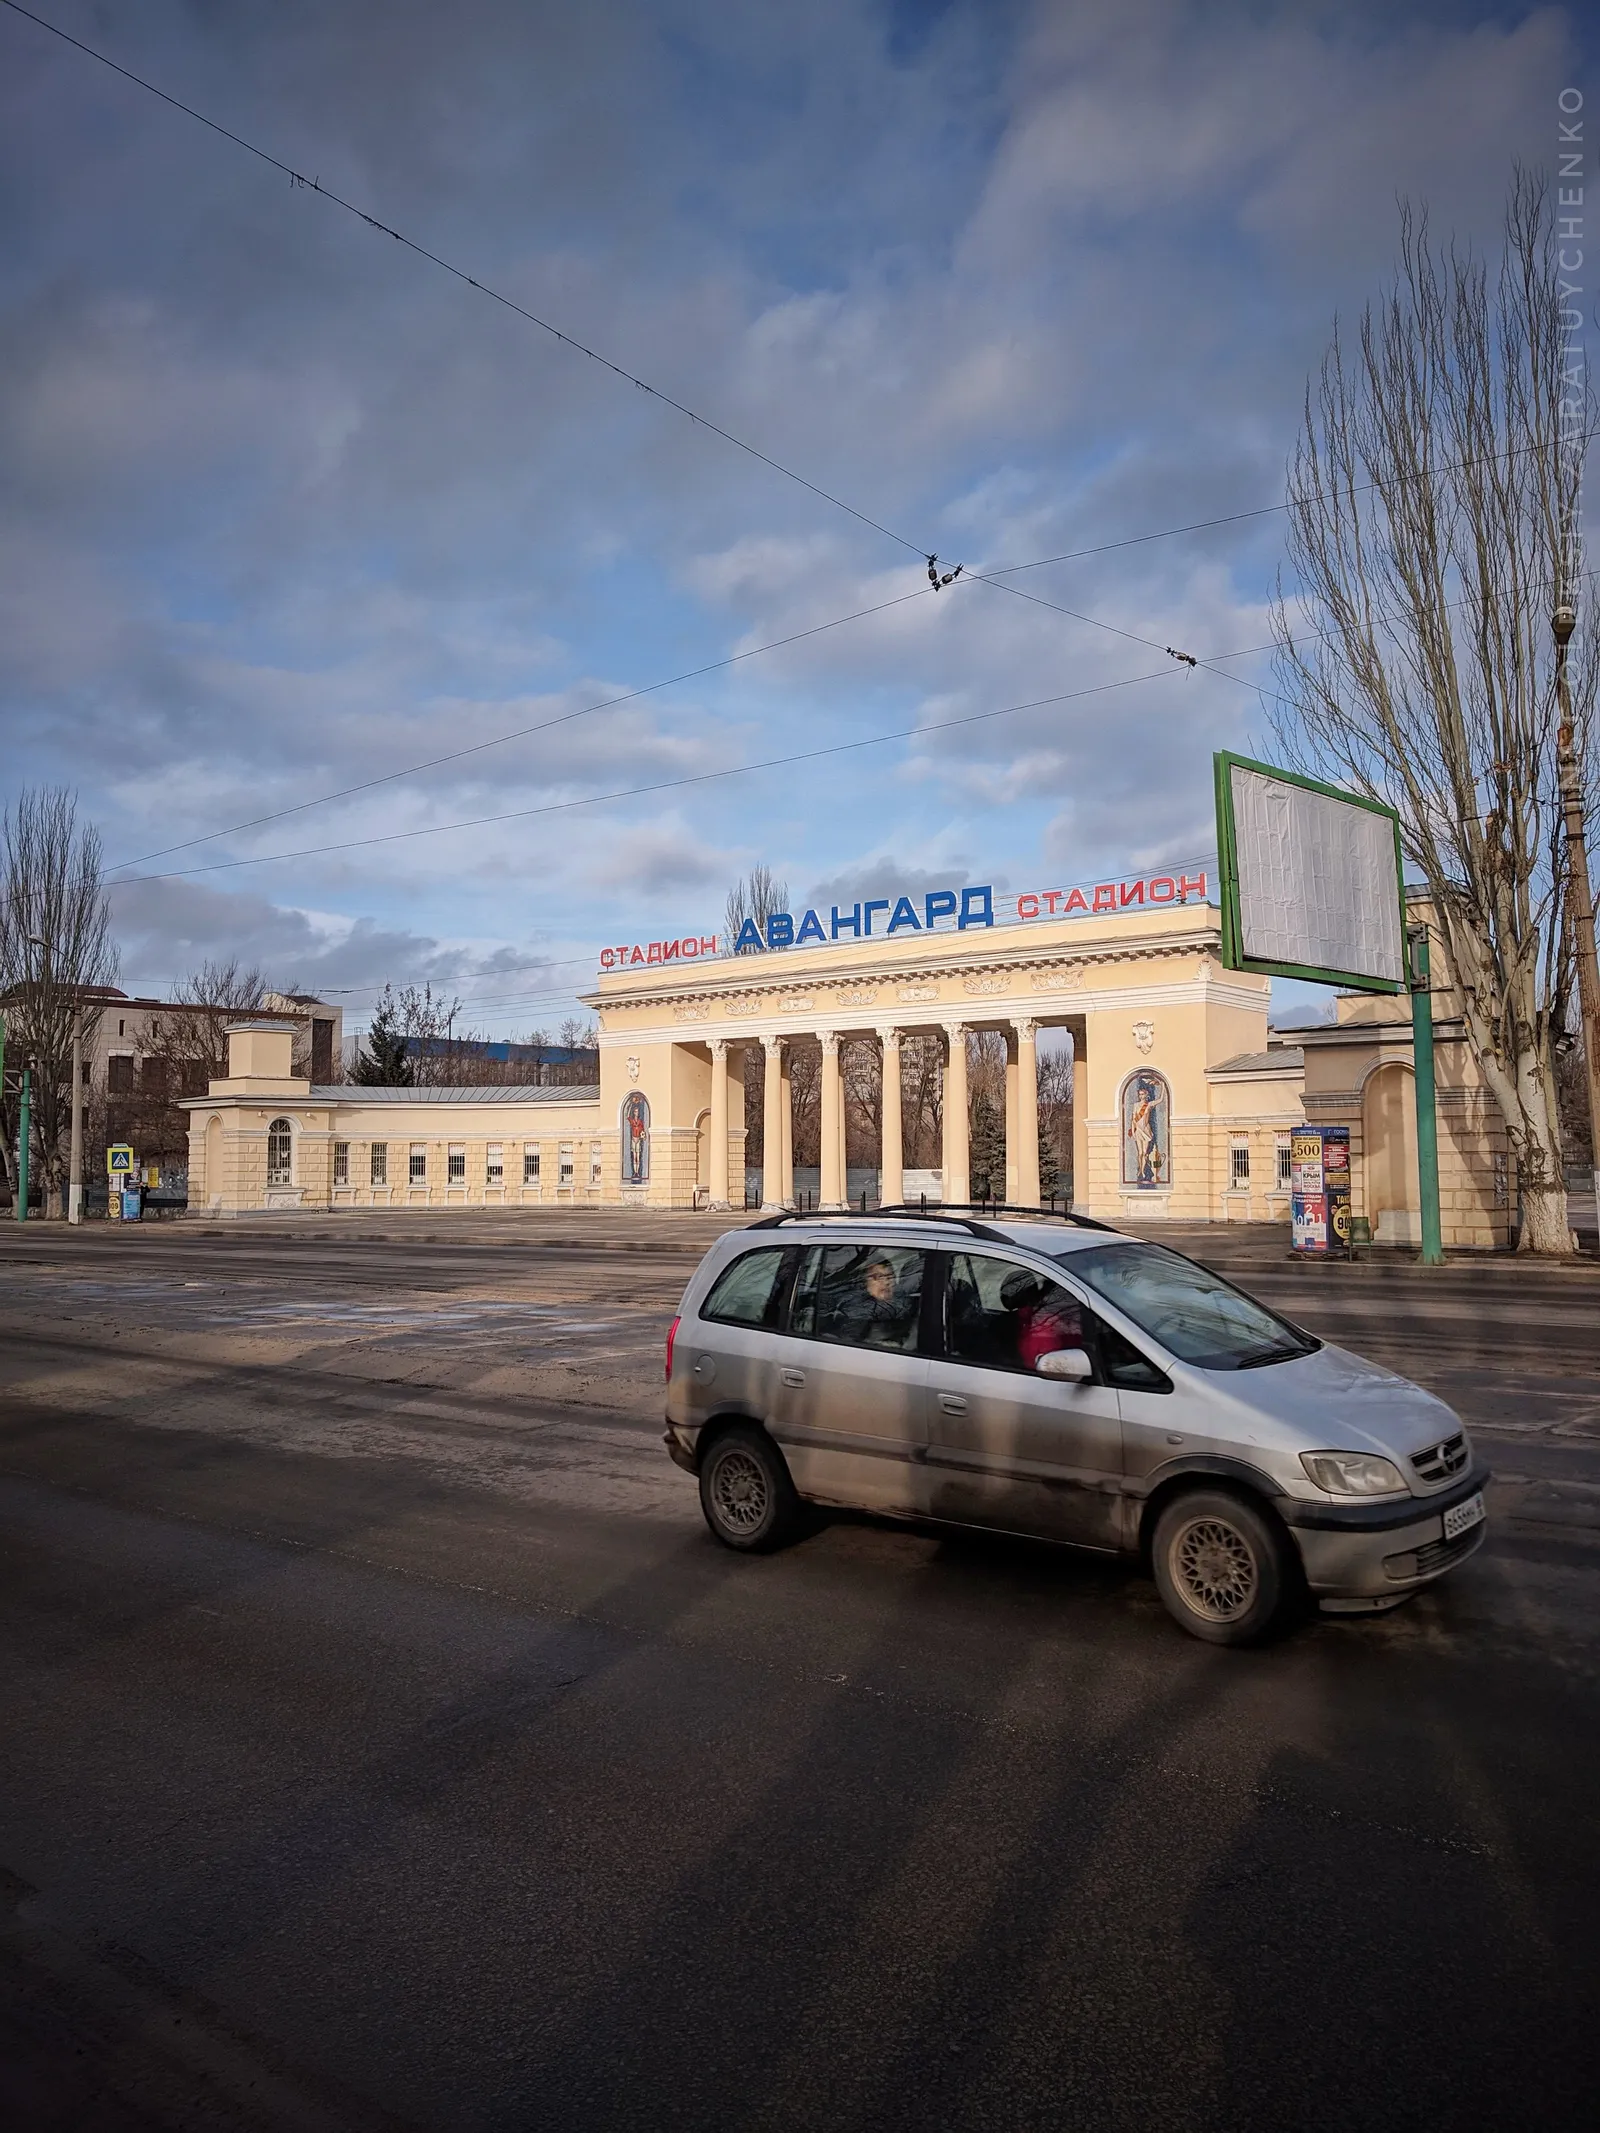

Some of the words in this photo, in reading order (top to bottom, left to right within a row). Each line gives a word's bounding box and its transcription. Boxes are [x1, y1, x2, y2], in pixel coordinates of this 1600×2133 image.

[600, 935, 718, 967] СТАДИОН
[733, 885, 994, 951] АВАНГАРД
[1018, 872, 1208, 918] СТАДИОН
[1297, 1144, 1320, 1157] 500
